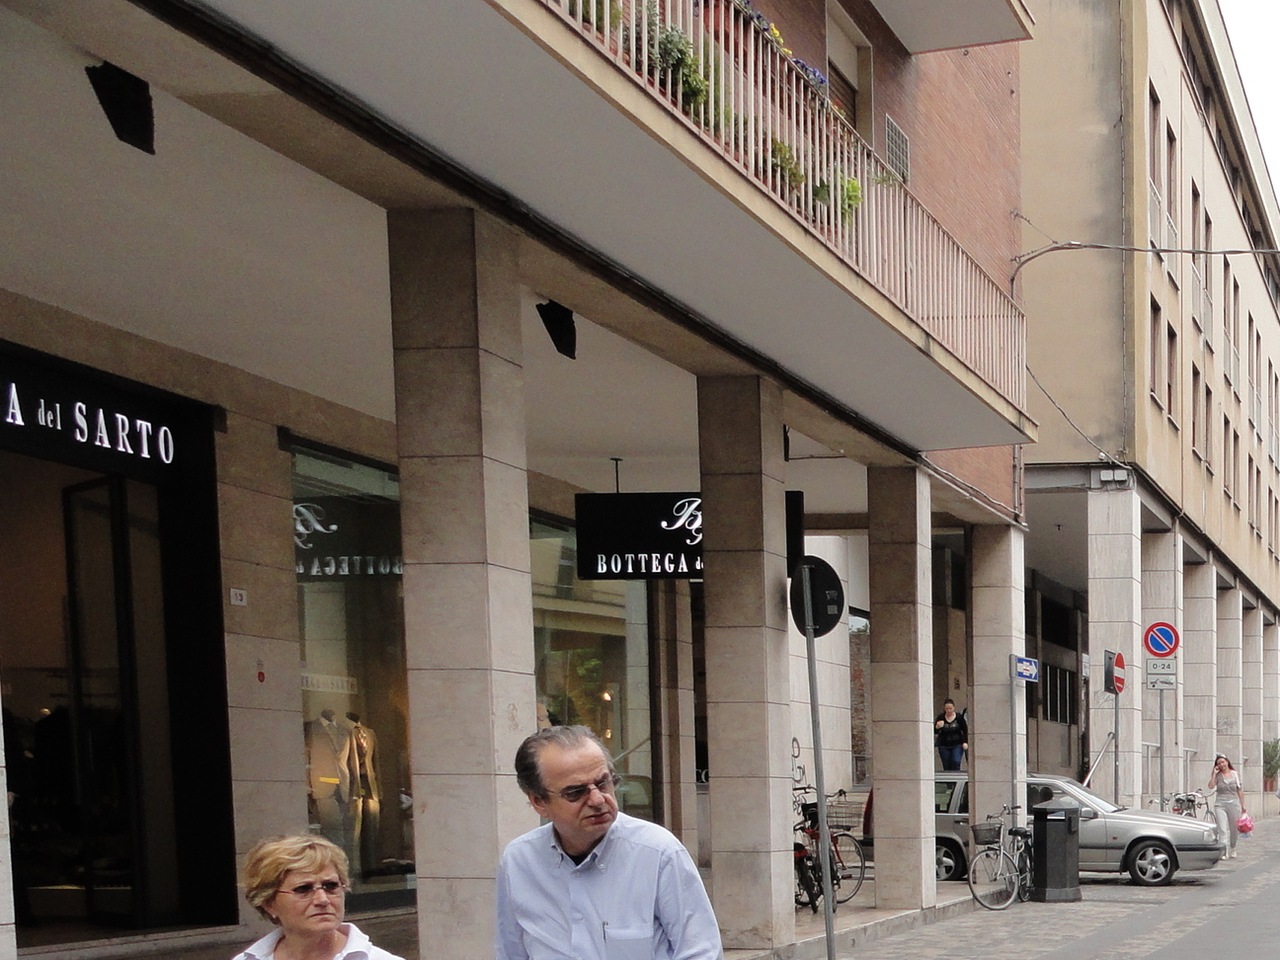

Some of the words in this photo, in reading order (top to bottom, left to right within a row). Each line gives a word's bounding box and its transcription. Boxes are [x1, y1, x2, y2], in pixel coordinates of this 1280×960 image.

[38, 399, 62, 430] del
[75, 402, 174, 464] SARTO
[597, 553, 689, 574] BOTTEGA
